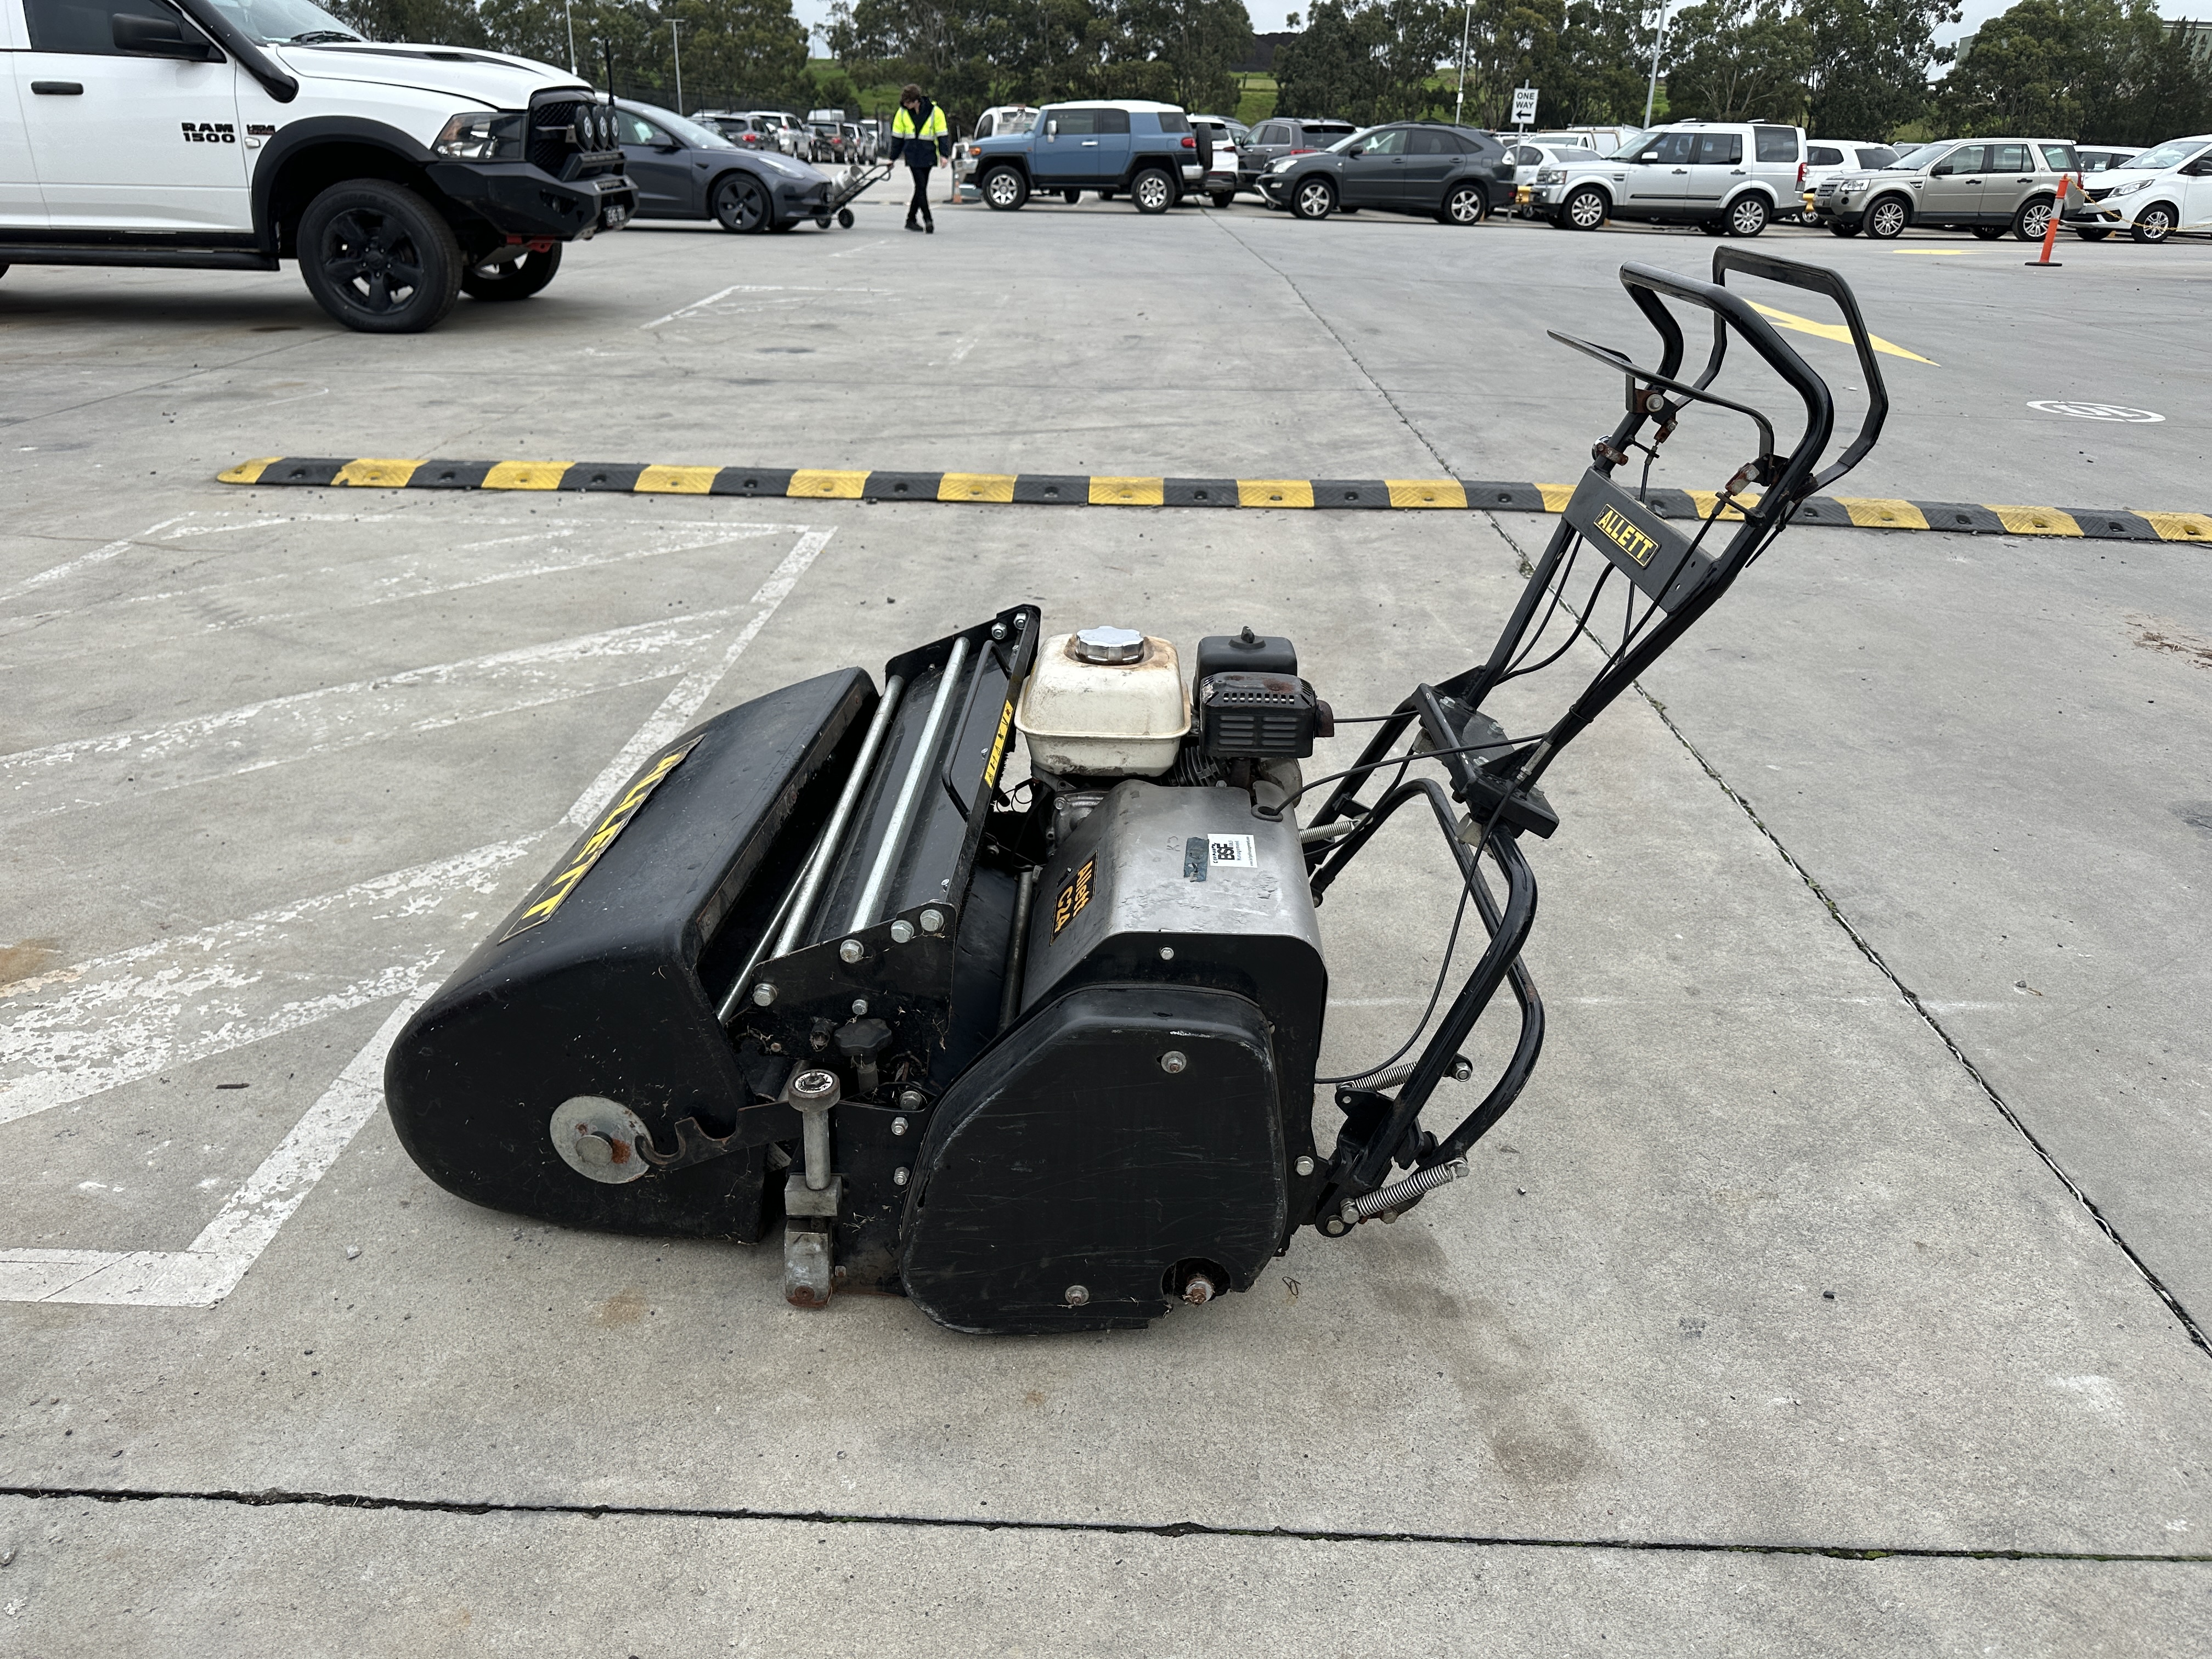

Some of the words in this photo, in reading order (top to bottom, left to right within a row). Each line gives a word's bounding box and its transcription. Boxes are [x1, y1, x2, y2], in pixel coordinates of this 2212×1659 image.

[182, 122, 234, 133] RAM
[183, 133, 235, 143] 1500
[1598, 510, 1654, 560] ALLETT
[1216, 843, 1235, 860] BSF
[1073, 860, 1093, 917] Allett
[1054, 885, 1073, 933] C24
